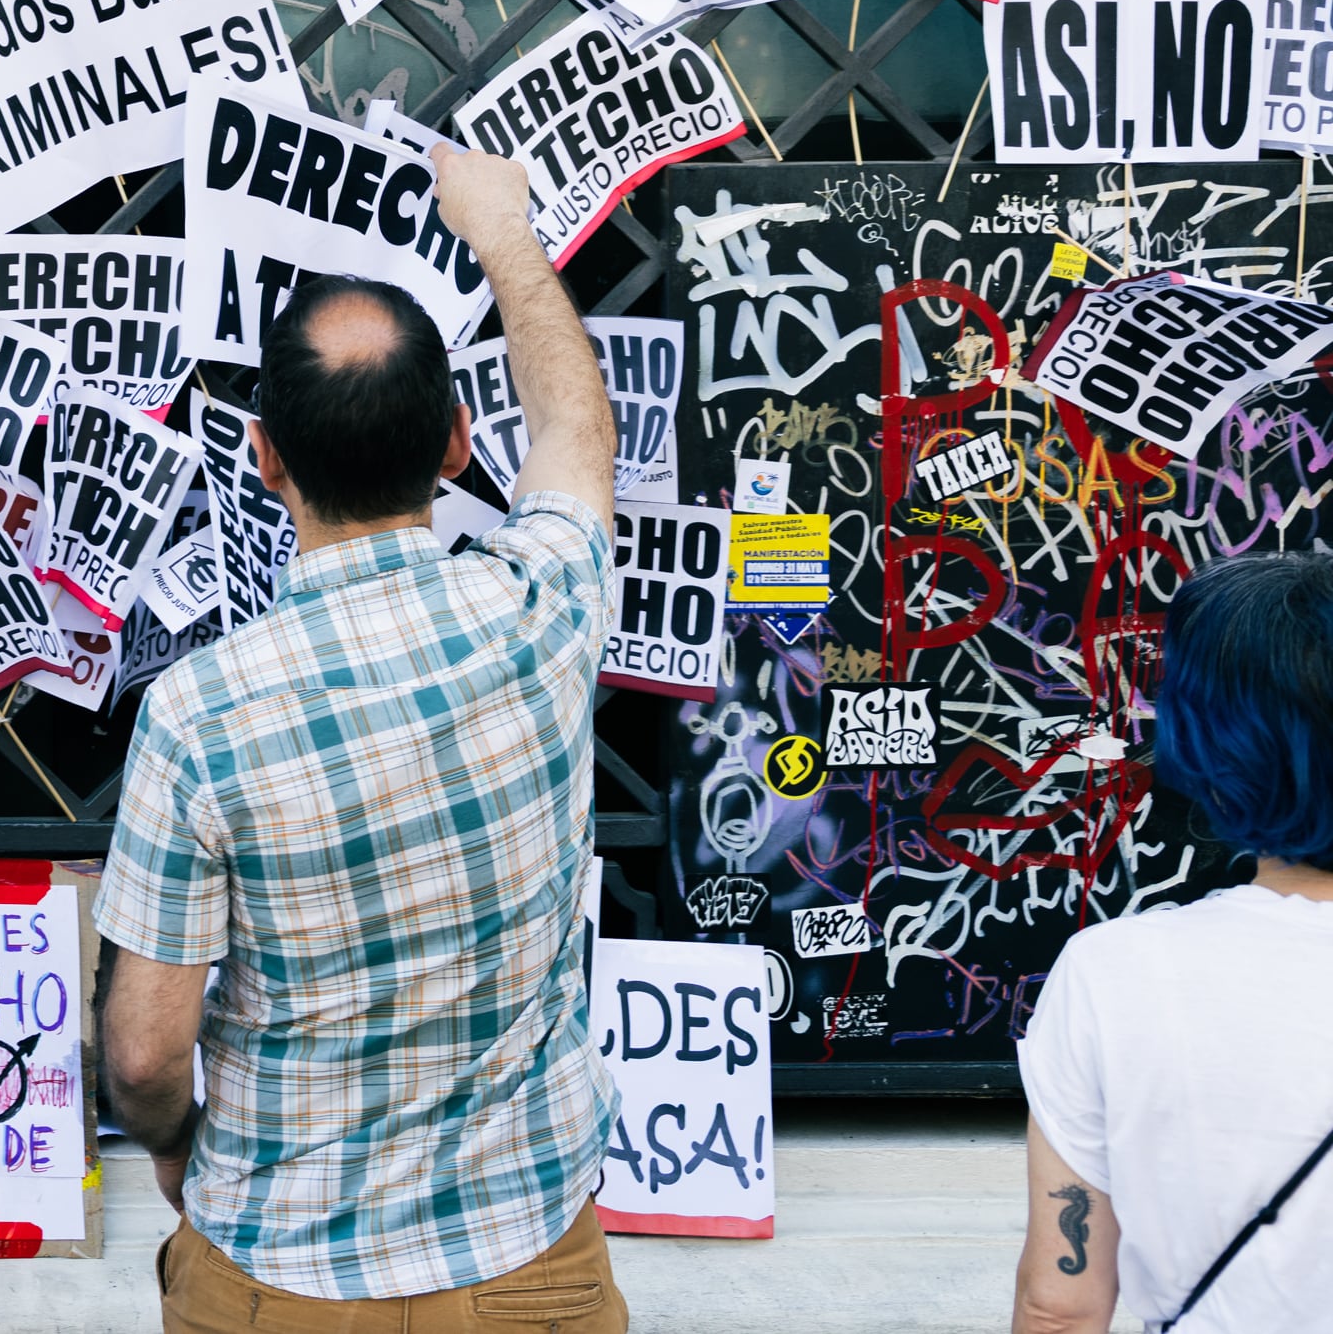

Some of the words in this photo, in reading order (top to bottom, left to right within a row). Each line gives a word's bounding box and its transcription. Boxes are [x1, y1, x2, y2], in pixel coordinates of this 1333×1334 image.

[531, 48, 714, 192] TECHO
[552, 162, 612, 237] JUSTO
[613, 97, 733, 174] PRECIO!
[915, 432, 1013, 500] TAKER
[744, 549, 824, 557] MANIFESTACIÓN
[154, 572, 173, 601] PRECIO
[172, 598, 197, 617] JUSTO
[3, 913, 49, 954] ES
[5, 1125, 54, 1171] DE
